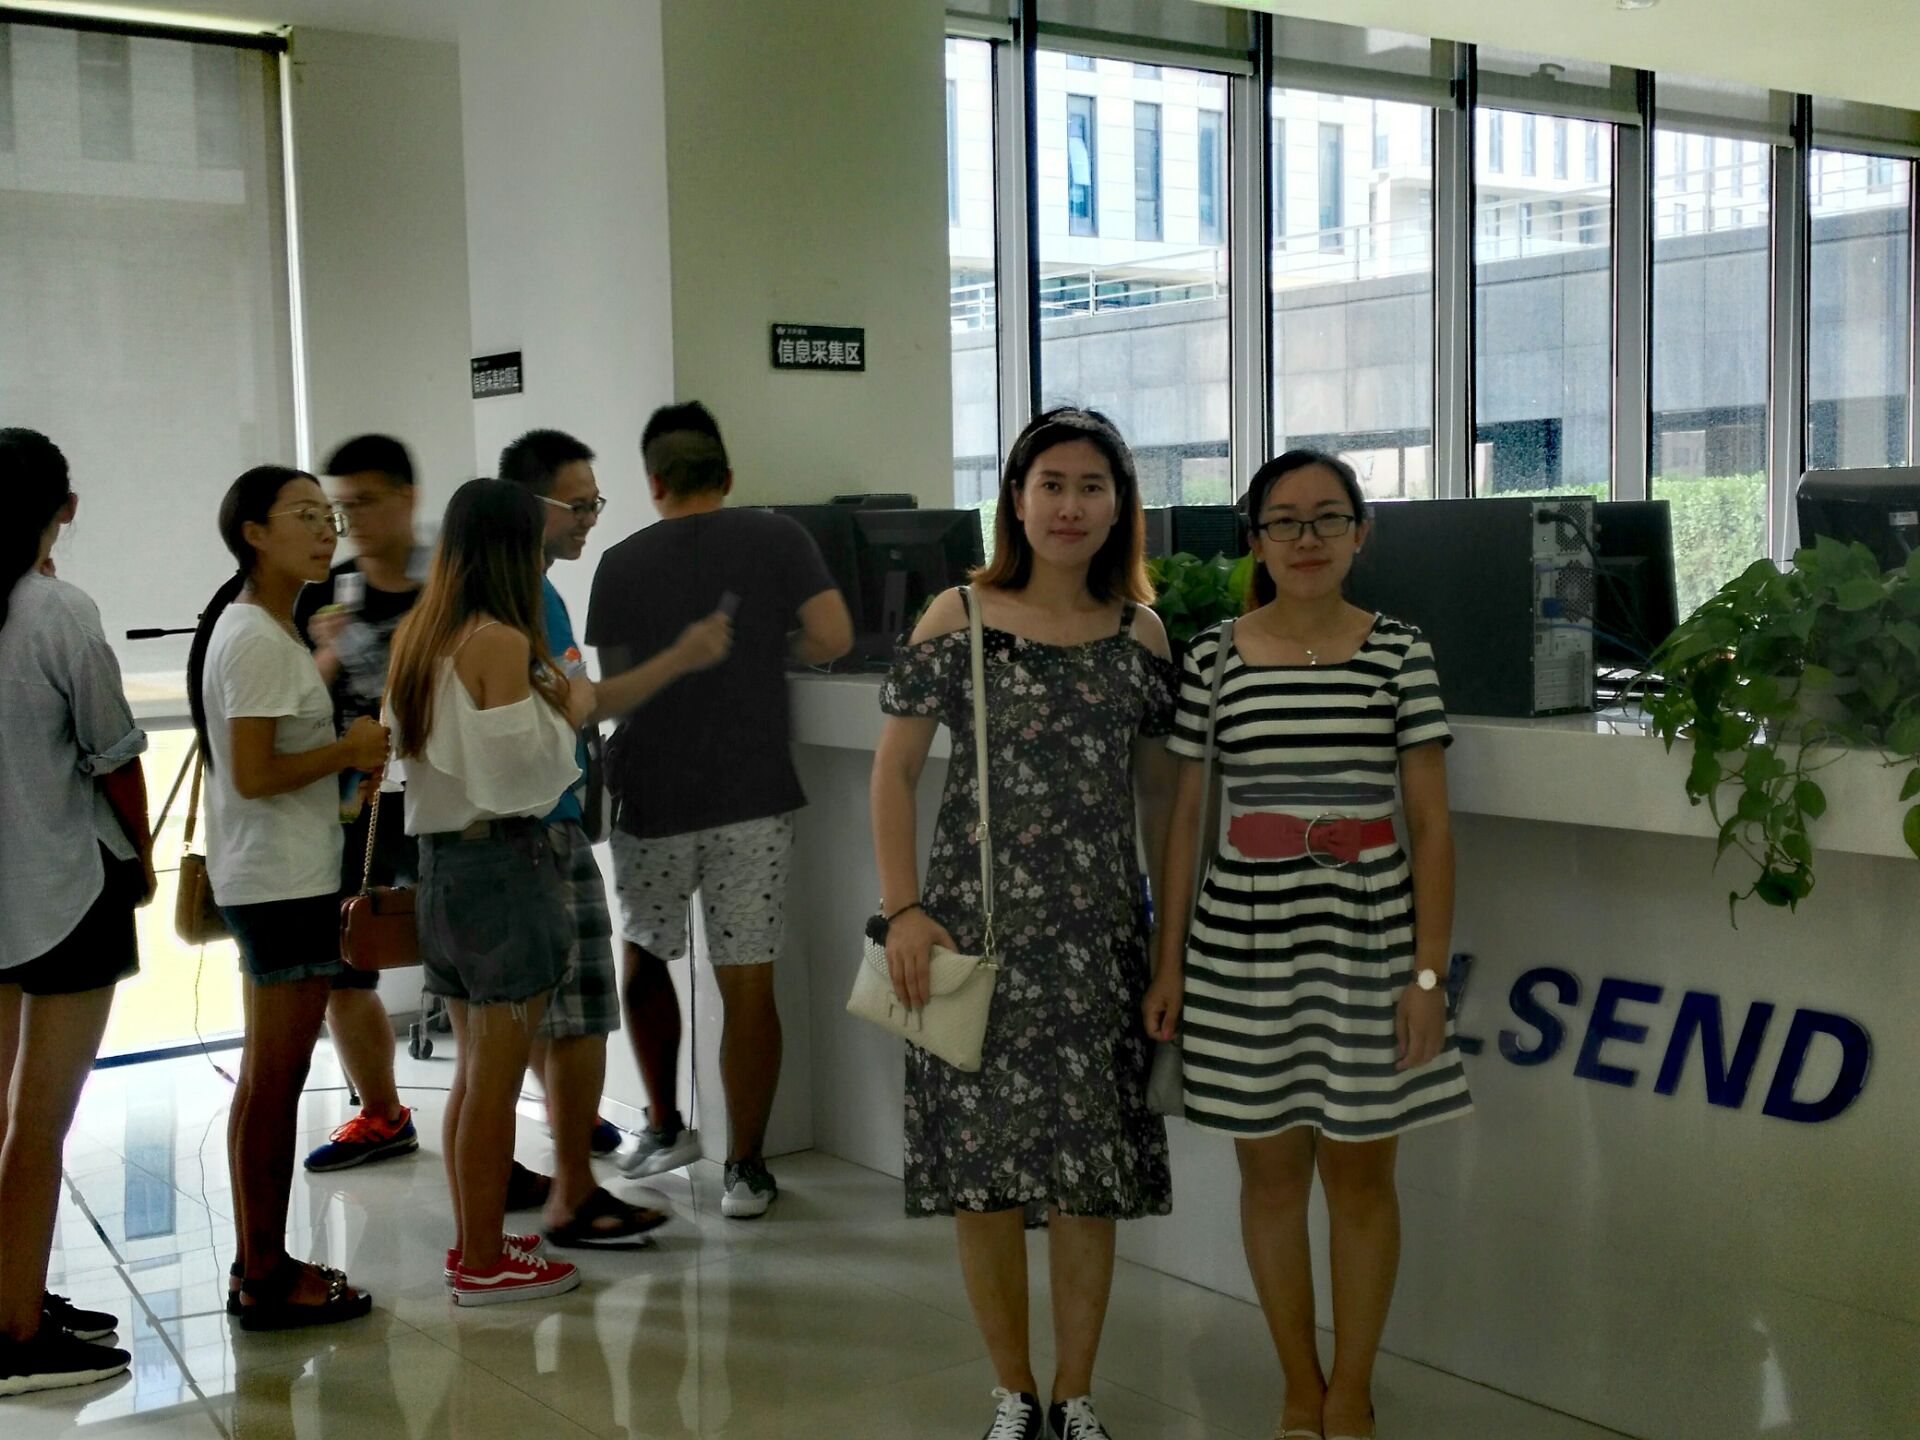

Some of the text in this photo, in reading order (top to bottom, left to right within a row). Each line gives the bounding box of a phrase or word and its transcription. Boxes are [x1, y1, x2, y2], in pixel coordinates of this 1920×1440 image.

[778, 338, 861, 365] 信息采集区
